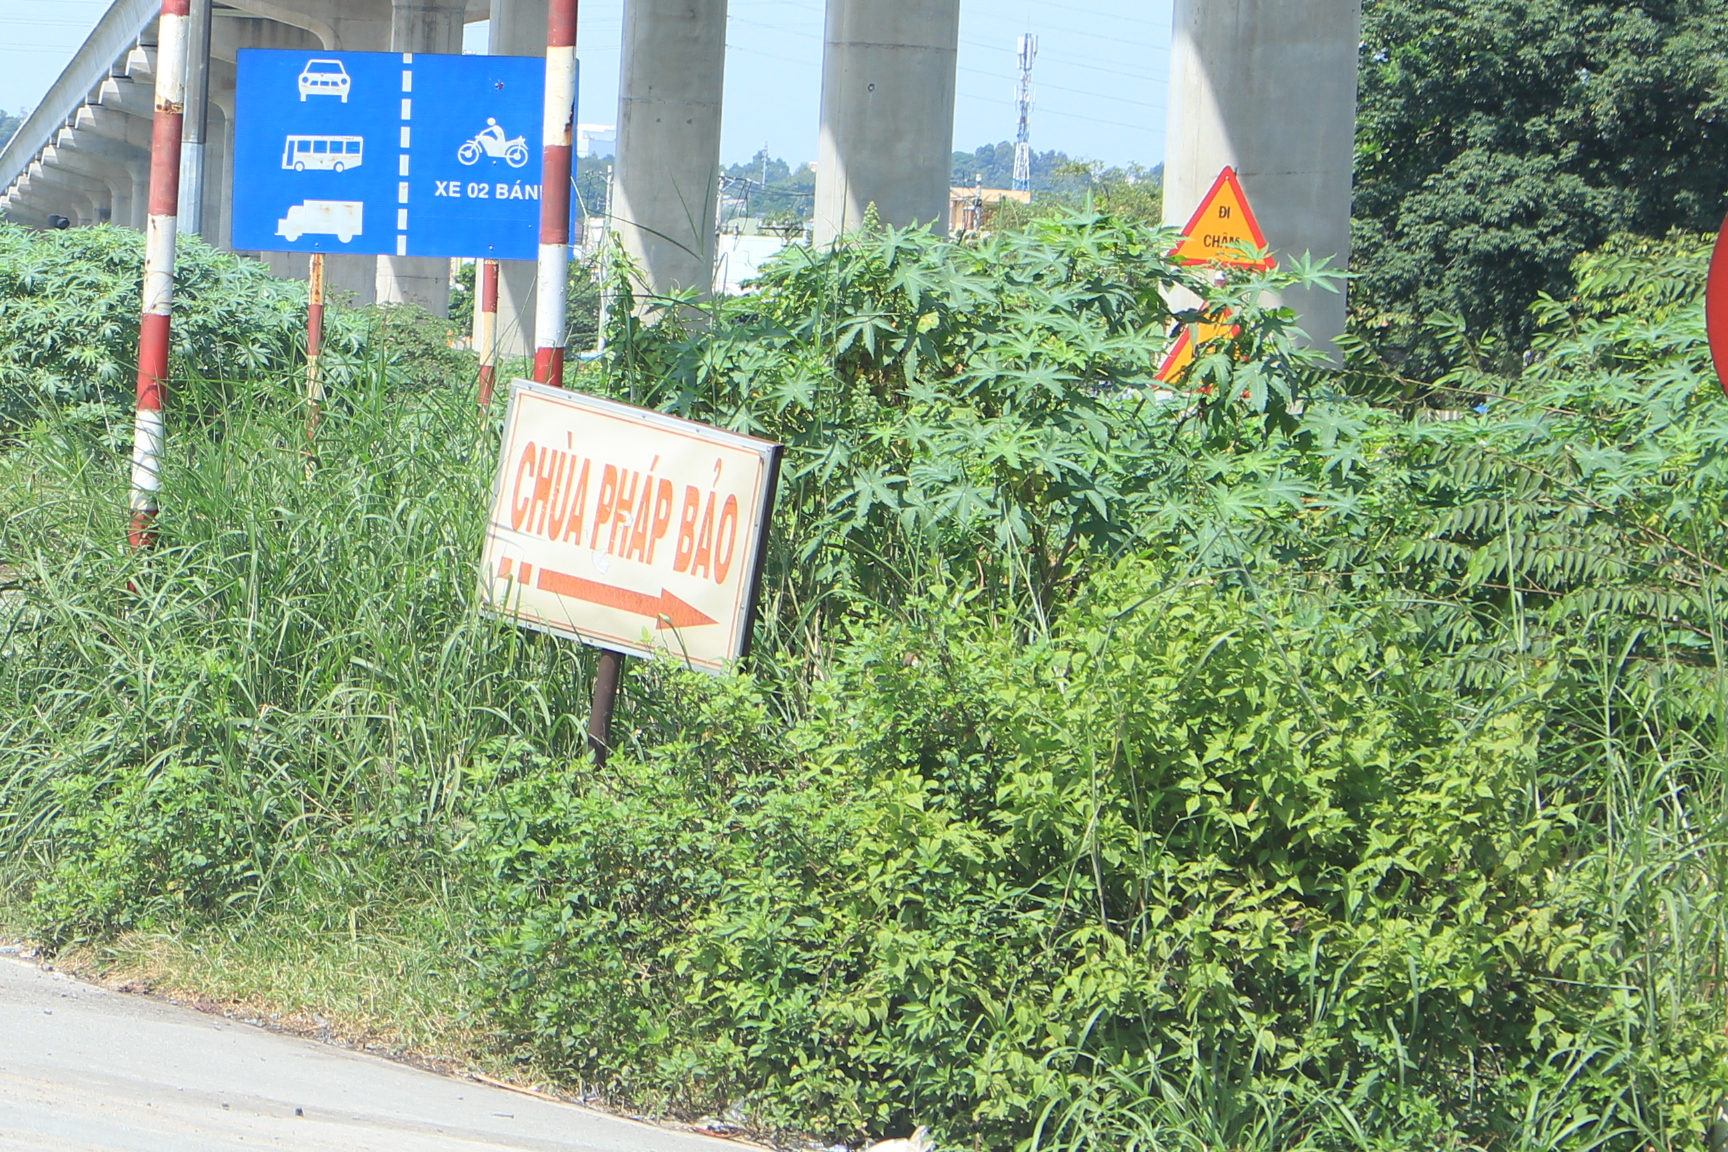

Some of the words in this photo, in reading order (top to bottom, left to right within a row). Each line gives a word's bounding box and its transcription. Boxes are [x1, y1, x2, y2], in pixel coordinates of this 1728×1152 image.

[434, 180, 461, 198] XE
[467, 182, 490, 199] 02
[495, 179, 543, 200] BÁN
[510, 430, 591, 546] CHÙA
[589, 454, 674, 565] PHÁP
[672, 457, 738, 585] BẢO
